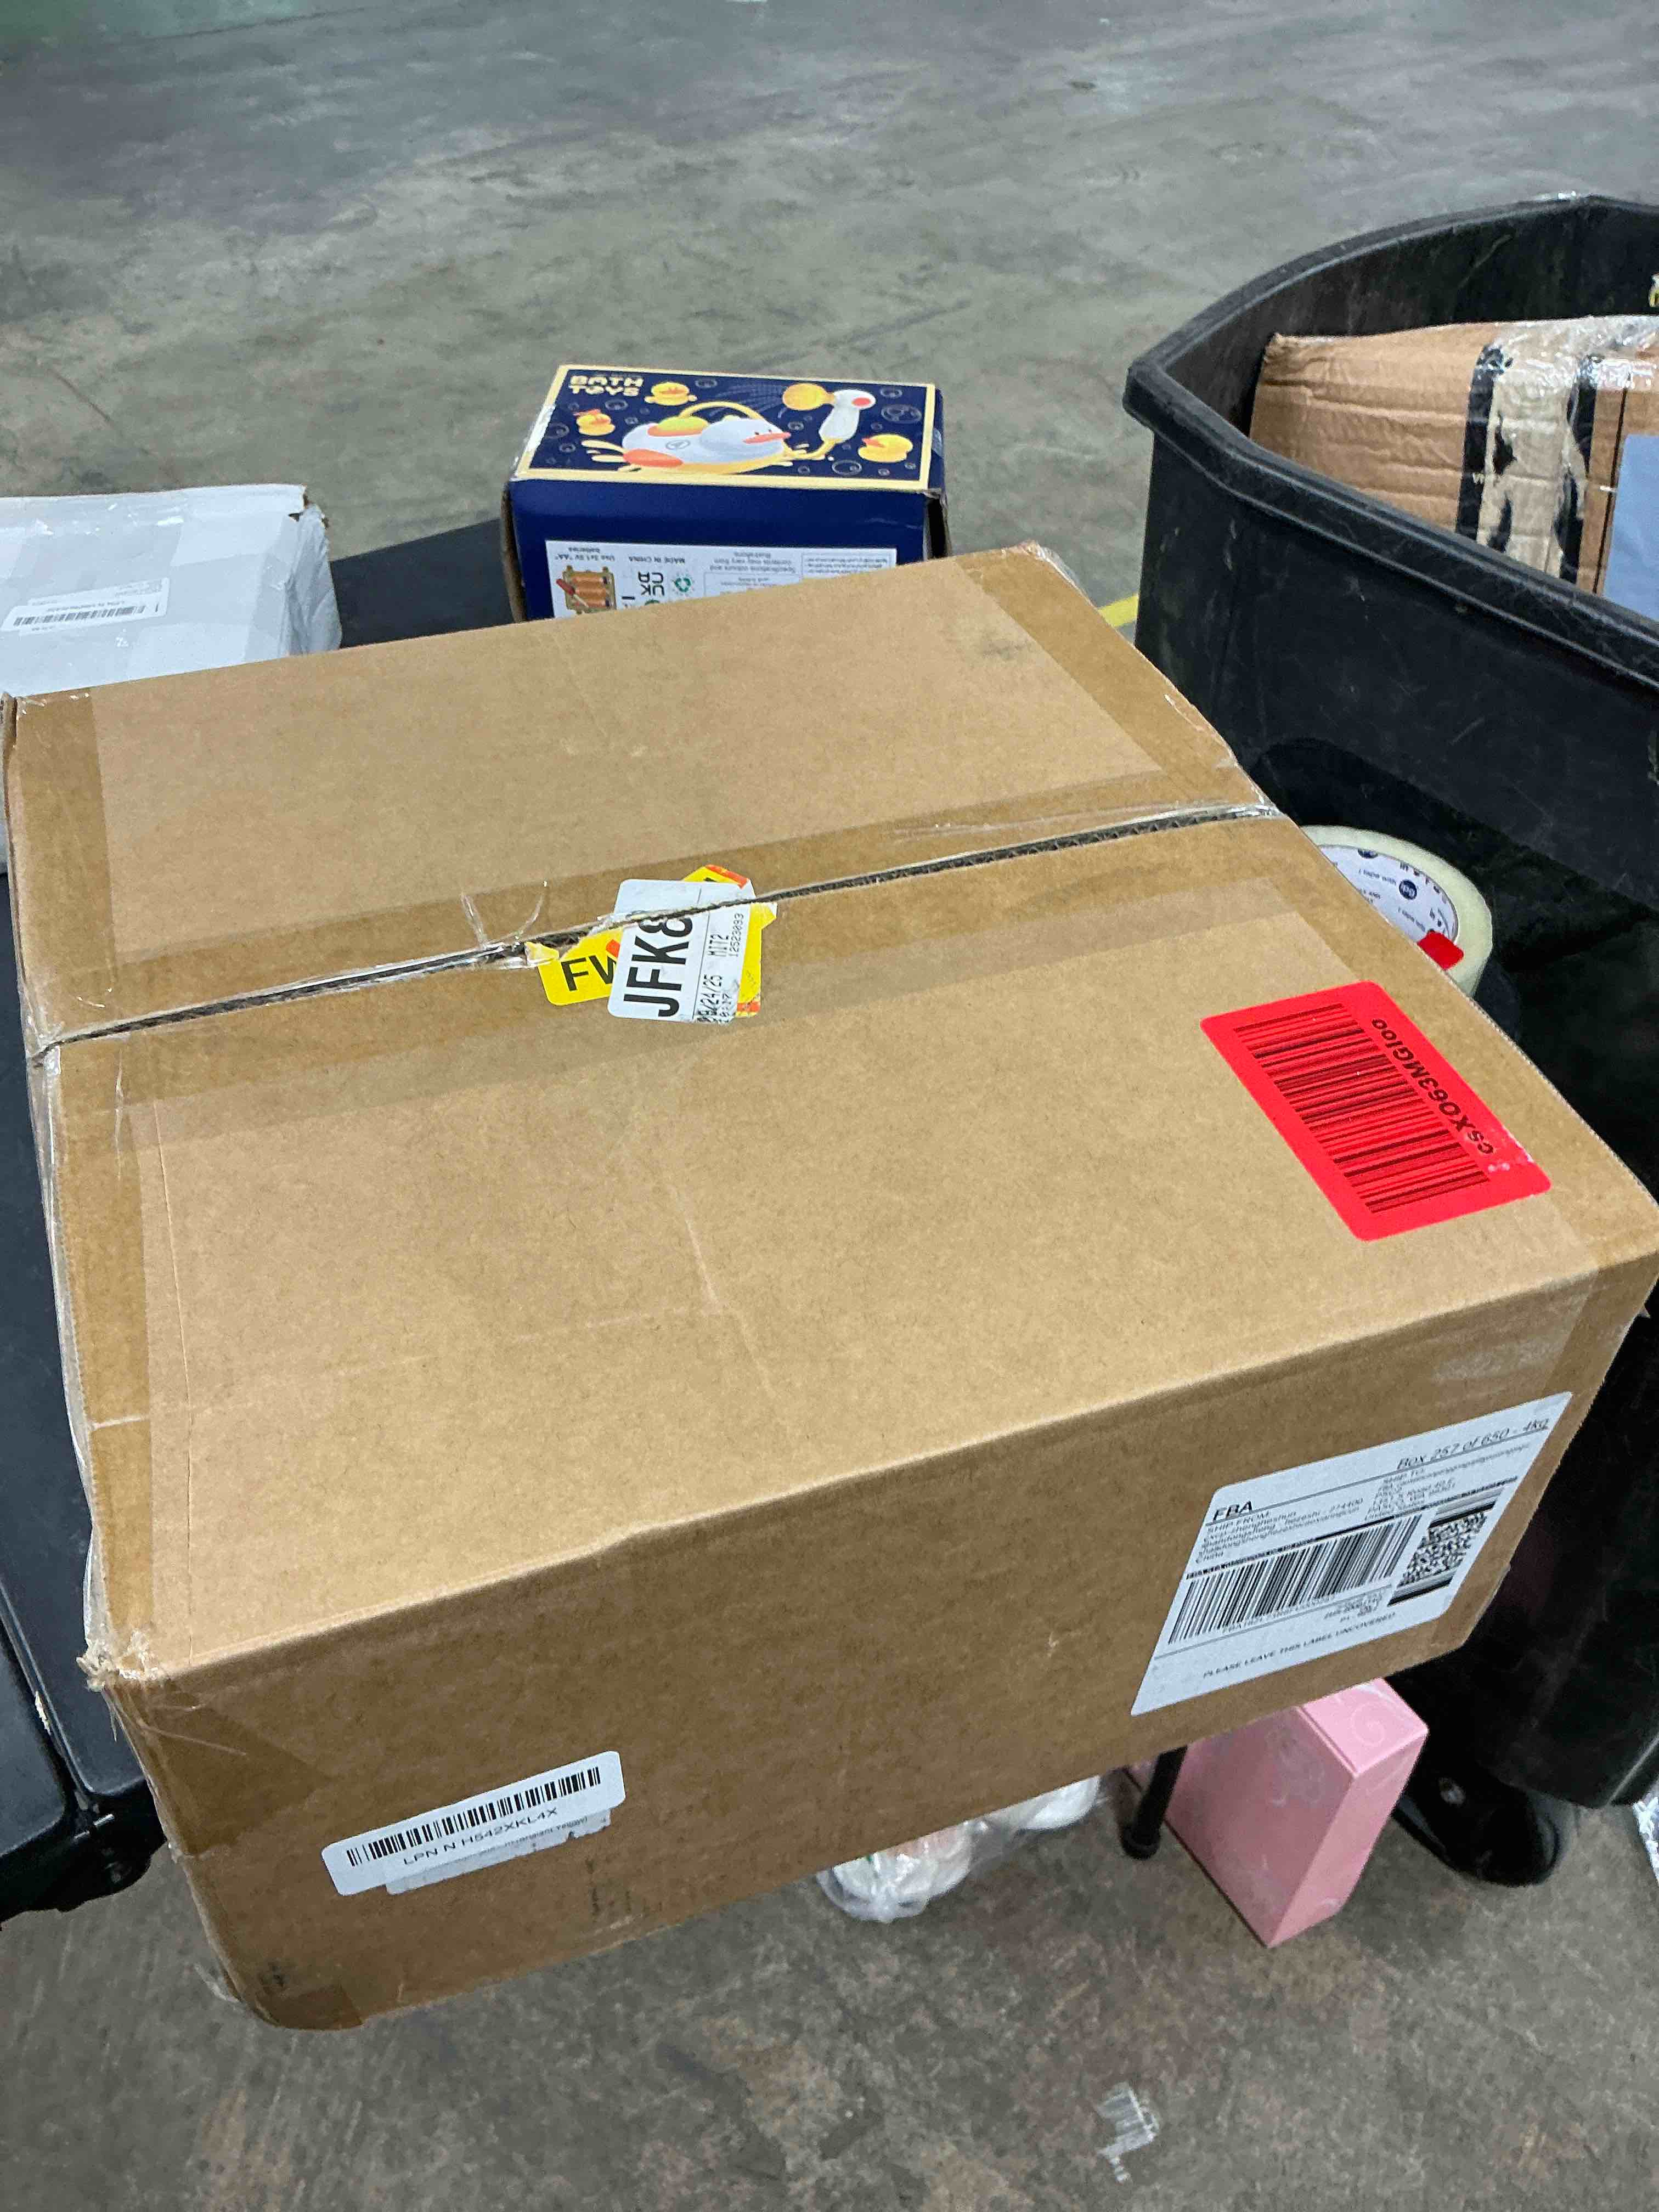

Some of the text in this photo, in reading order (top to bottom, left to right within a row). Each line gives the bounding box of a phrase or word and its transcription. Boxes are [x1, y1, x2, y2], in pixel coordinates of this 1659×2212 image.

[570, 375, 644, 387] BATH
[568, 385, 640, 397] TOYS
[706, 934, 729, 957] MIT2
[1462, 1435, 1482, 1452] of
[1212, 1500, 1253, 1522] FBA
[1203, 1660, 1242, 1679] PLEASE
[1244, 1651, 1274, 1666] LEAVE
[1279, 1641, 1301, 1654] THIS
[1304, 1633, 1332, 1646] LABEL
[403, 1848, 438, 1865] LPN
